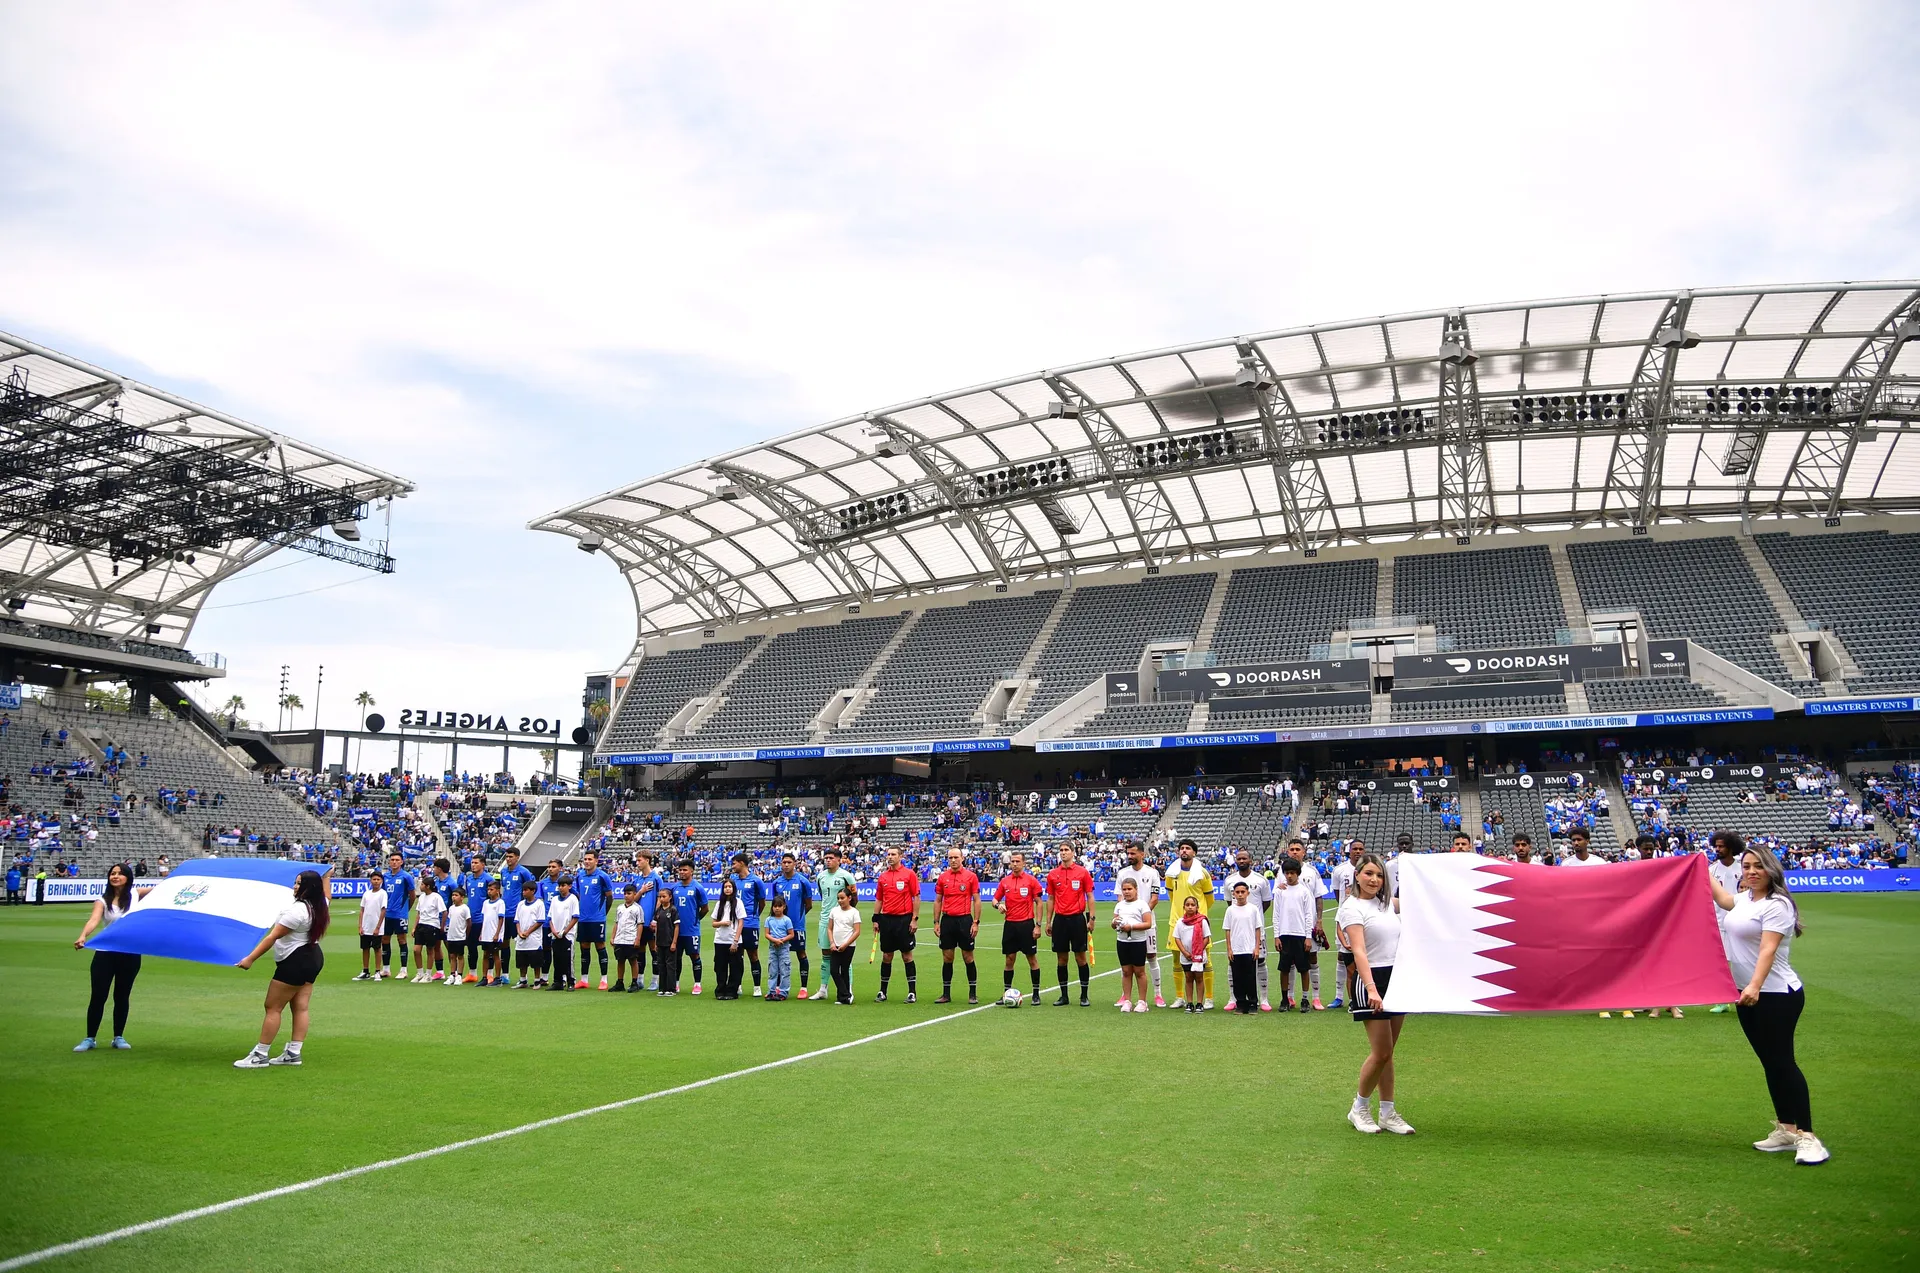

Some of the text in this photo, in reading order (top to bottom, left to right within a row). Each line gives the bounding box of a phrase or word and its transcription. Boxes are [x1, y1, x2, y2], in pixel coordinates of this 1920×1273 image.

[1476, 653, 1570, 671] DOORDASH
[1235, 668, 1321, 685] DOORDASH
[1822, 700, 1908, 713] MASTERS EVENTS
[1665, 711, 1754, 723] MASTERS EVENTS
[1507, 722, 1532, 731] UNIENDO
[1533, 720, 1563, 730] CULTURAS
[1564, 720, 1570, 728] A
[1570, 717, 1593, 727] TRAVÉS
[1594, 718, 1605, 727] DEL
[1185, 734, 1260, 745] MASTERS EVENTS
[978, 741, 1005, 749] EVENTS
[1052, 743, 1074, 751] UNIENDO
[1075, 742, 1100, 750] CULTURAS
[1100, 741, 1105, 749] A
[1126, 740, 1135, 748] DEL
[797, 749, 821, 757] EVENTS
[620, 755, 646, 763] MASTERS
[1729, 768, 1750, 776] BMO
[1494, 778, 1518, 786] BMO
[1544, 776, 1568, 785] BMO
[1090, 791, 1106, 799] BMO
[1130, 790, 1147, 798] BMO
[48, 884, 88, 896] BRINGING
[386, 883, 395, 893] 20
[506, 880, 511, 890] 2
[584, 885, 589, 895] 7
[470, 888, 475, 897] 5
[782, 890, 791, 900] 14
[678, 896, 686, 907] 12
[600, 924, 605, 933] 7
